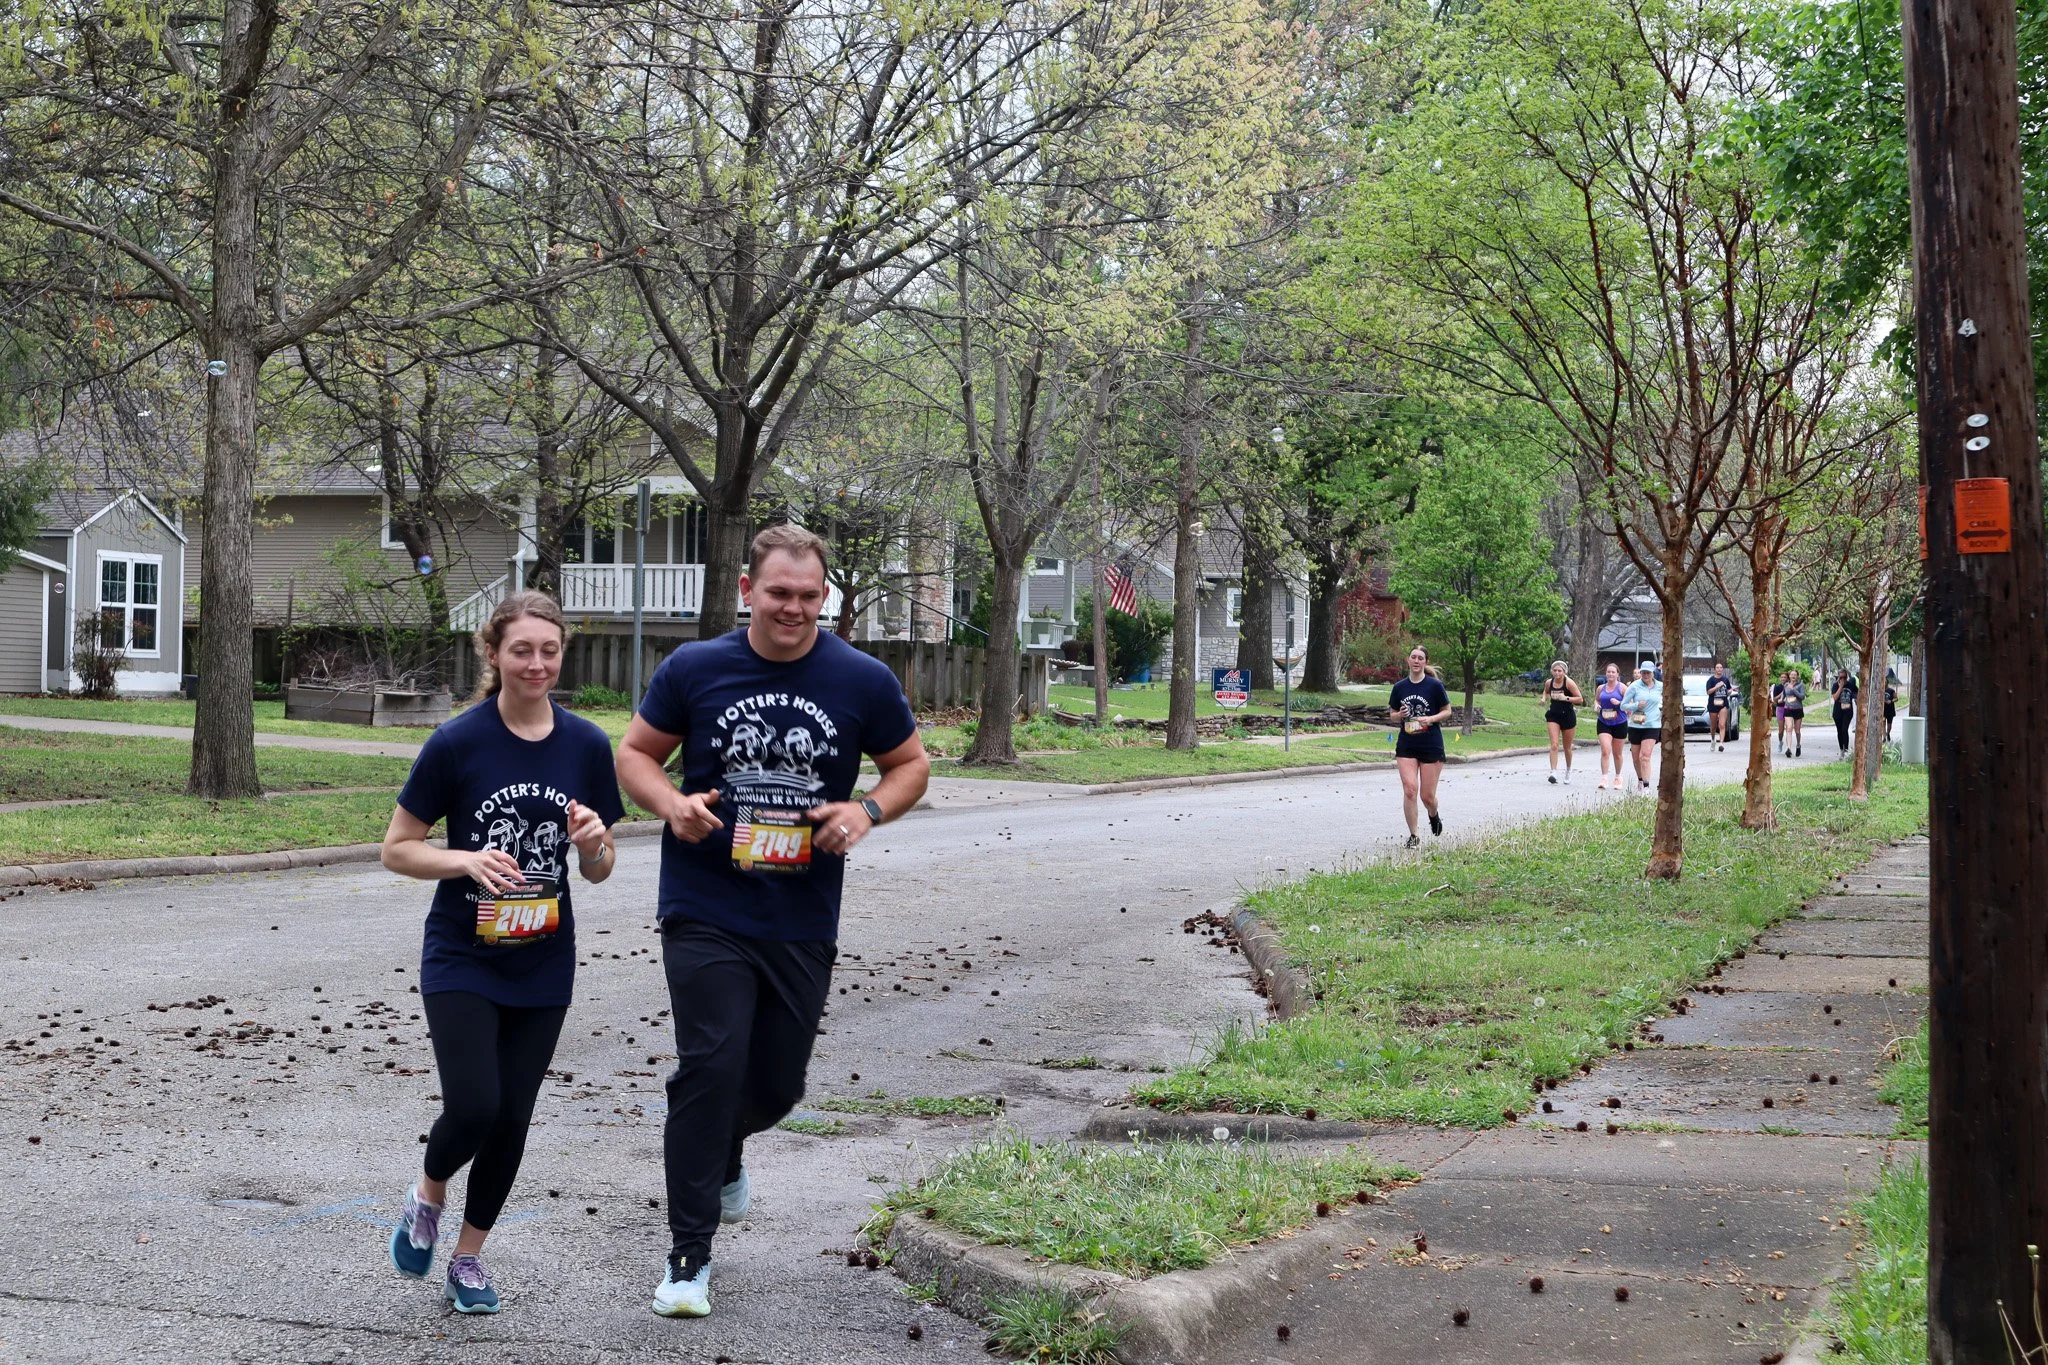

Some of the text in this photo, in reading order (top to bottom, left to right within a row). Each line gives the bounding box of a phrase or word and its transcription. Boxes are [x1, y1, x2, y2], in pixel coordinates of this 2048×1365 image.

[1969, 520, 1996, 528] CABLE
[1969, 540, 1998, 548] ROUTE
[716, 693, 838, 739] POTTER'S HOUSE
[711, 738, 722, 747] 20
[736, 786, 754, 794] STEVE
[474, 782, 540, 823] POTTER'S
[733, 793, 770, 804] ANNUAL
[794, 797, 810, 807] FUN
[471, 833, 479, 841] 20
[750, 830, 803, 858] 2149
[495, 904, 549, 932] 2148
